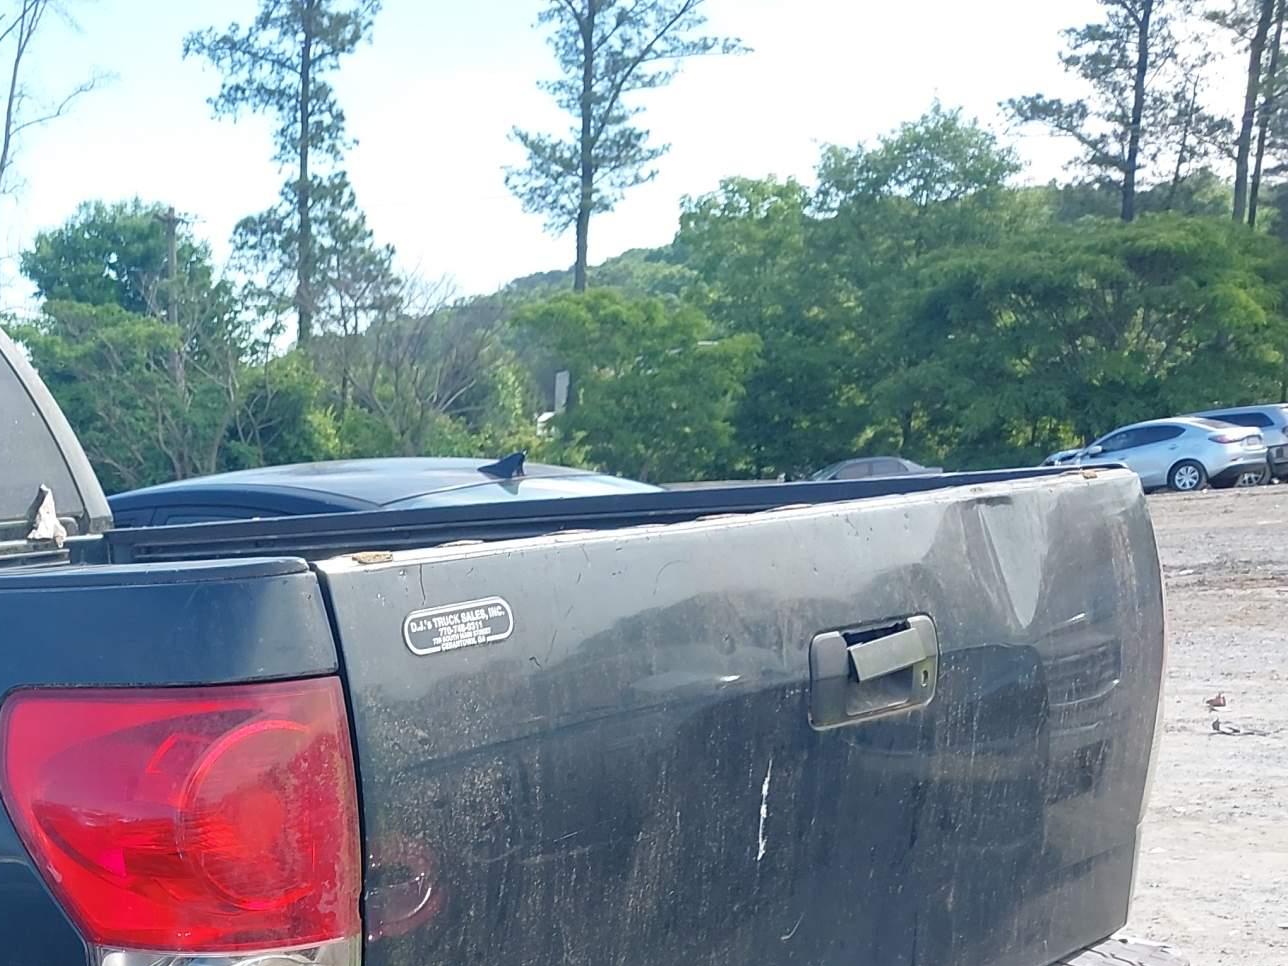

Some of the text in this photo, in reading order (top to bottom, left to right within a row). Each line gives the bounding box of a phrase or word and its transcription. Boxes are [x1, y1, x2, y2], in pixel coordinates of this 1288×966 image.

[432, 614, 460, 629] TRUCK
[460, 608, 489, 621] SALES,
[487, 605, 505, 618] INC.
